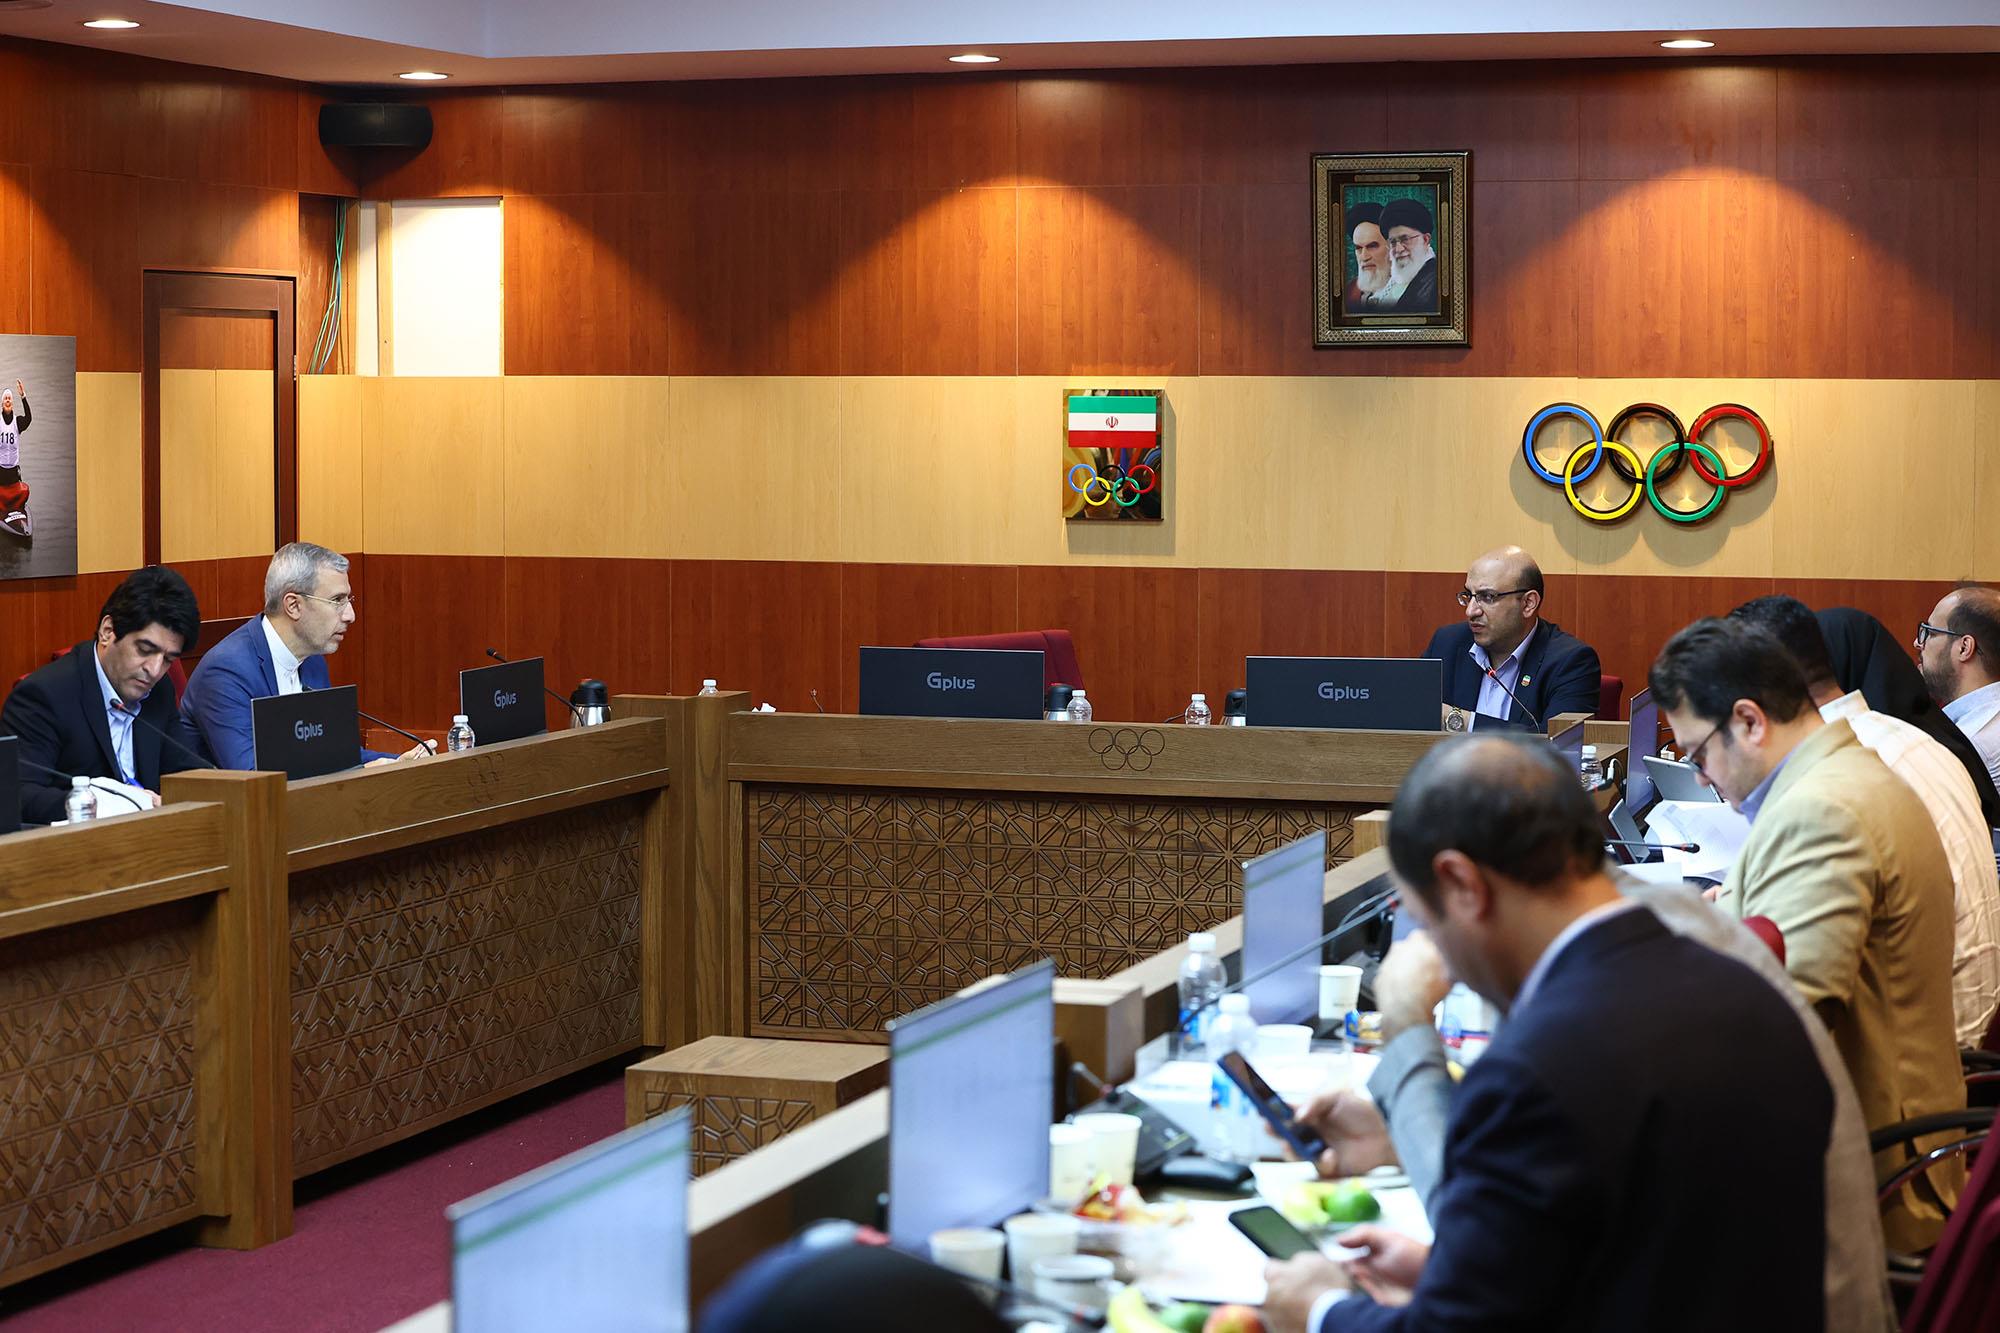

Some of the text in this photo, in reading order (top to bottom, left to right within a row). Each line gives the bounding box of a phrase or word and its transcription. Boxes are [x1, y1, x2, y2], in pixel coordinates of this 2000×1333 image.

[0, 432, 15, 445] 118
[927, 671, 976, 692] Gplus
[1317, 681, 1370, 702] Gplus
[494, 689, 517, 709] Gplus
[294, 719, 324, 742] Gplus
